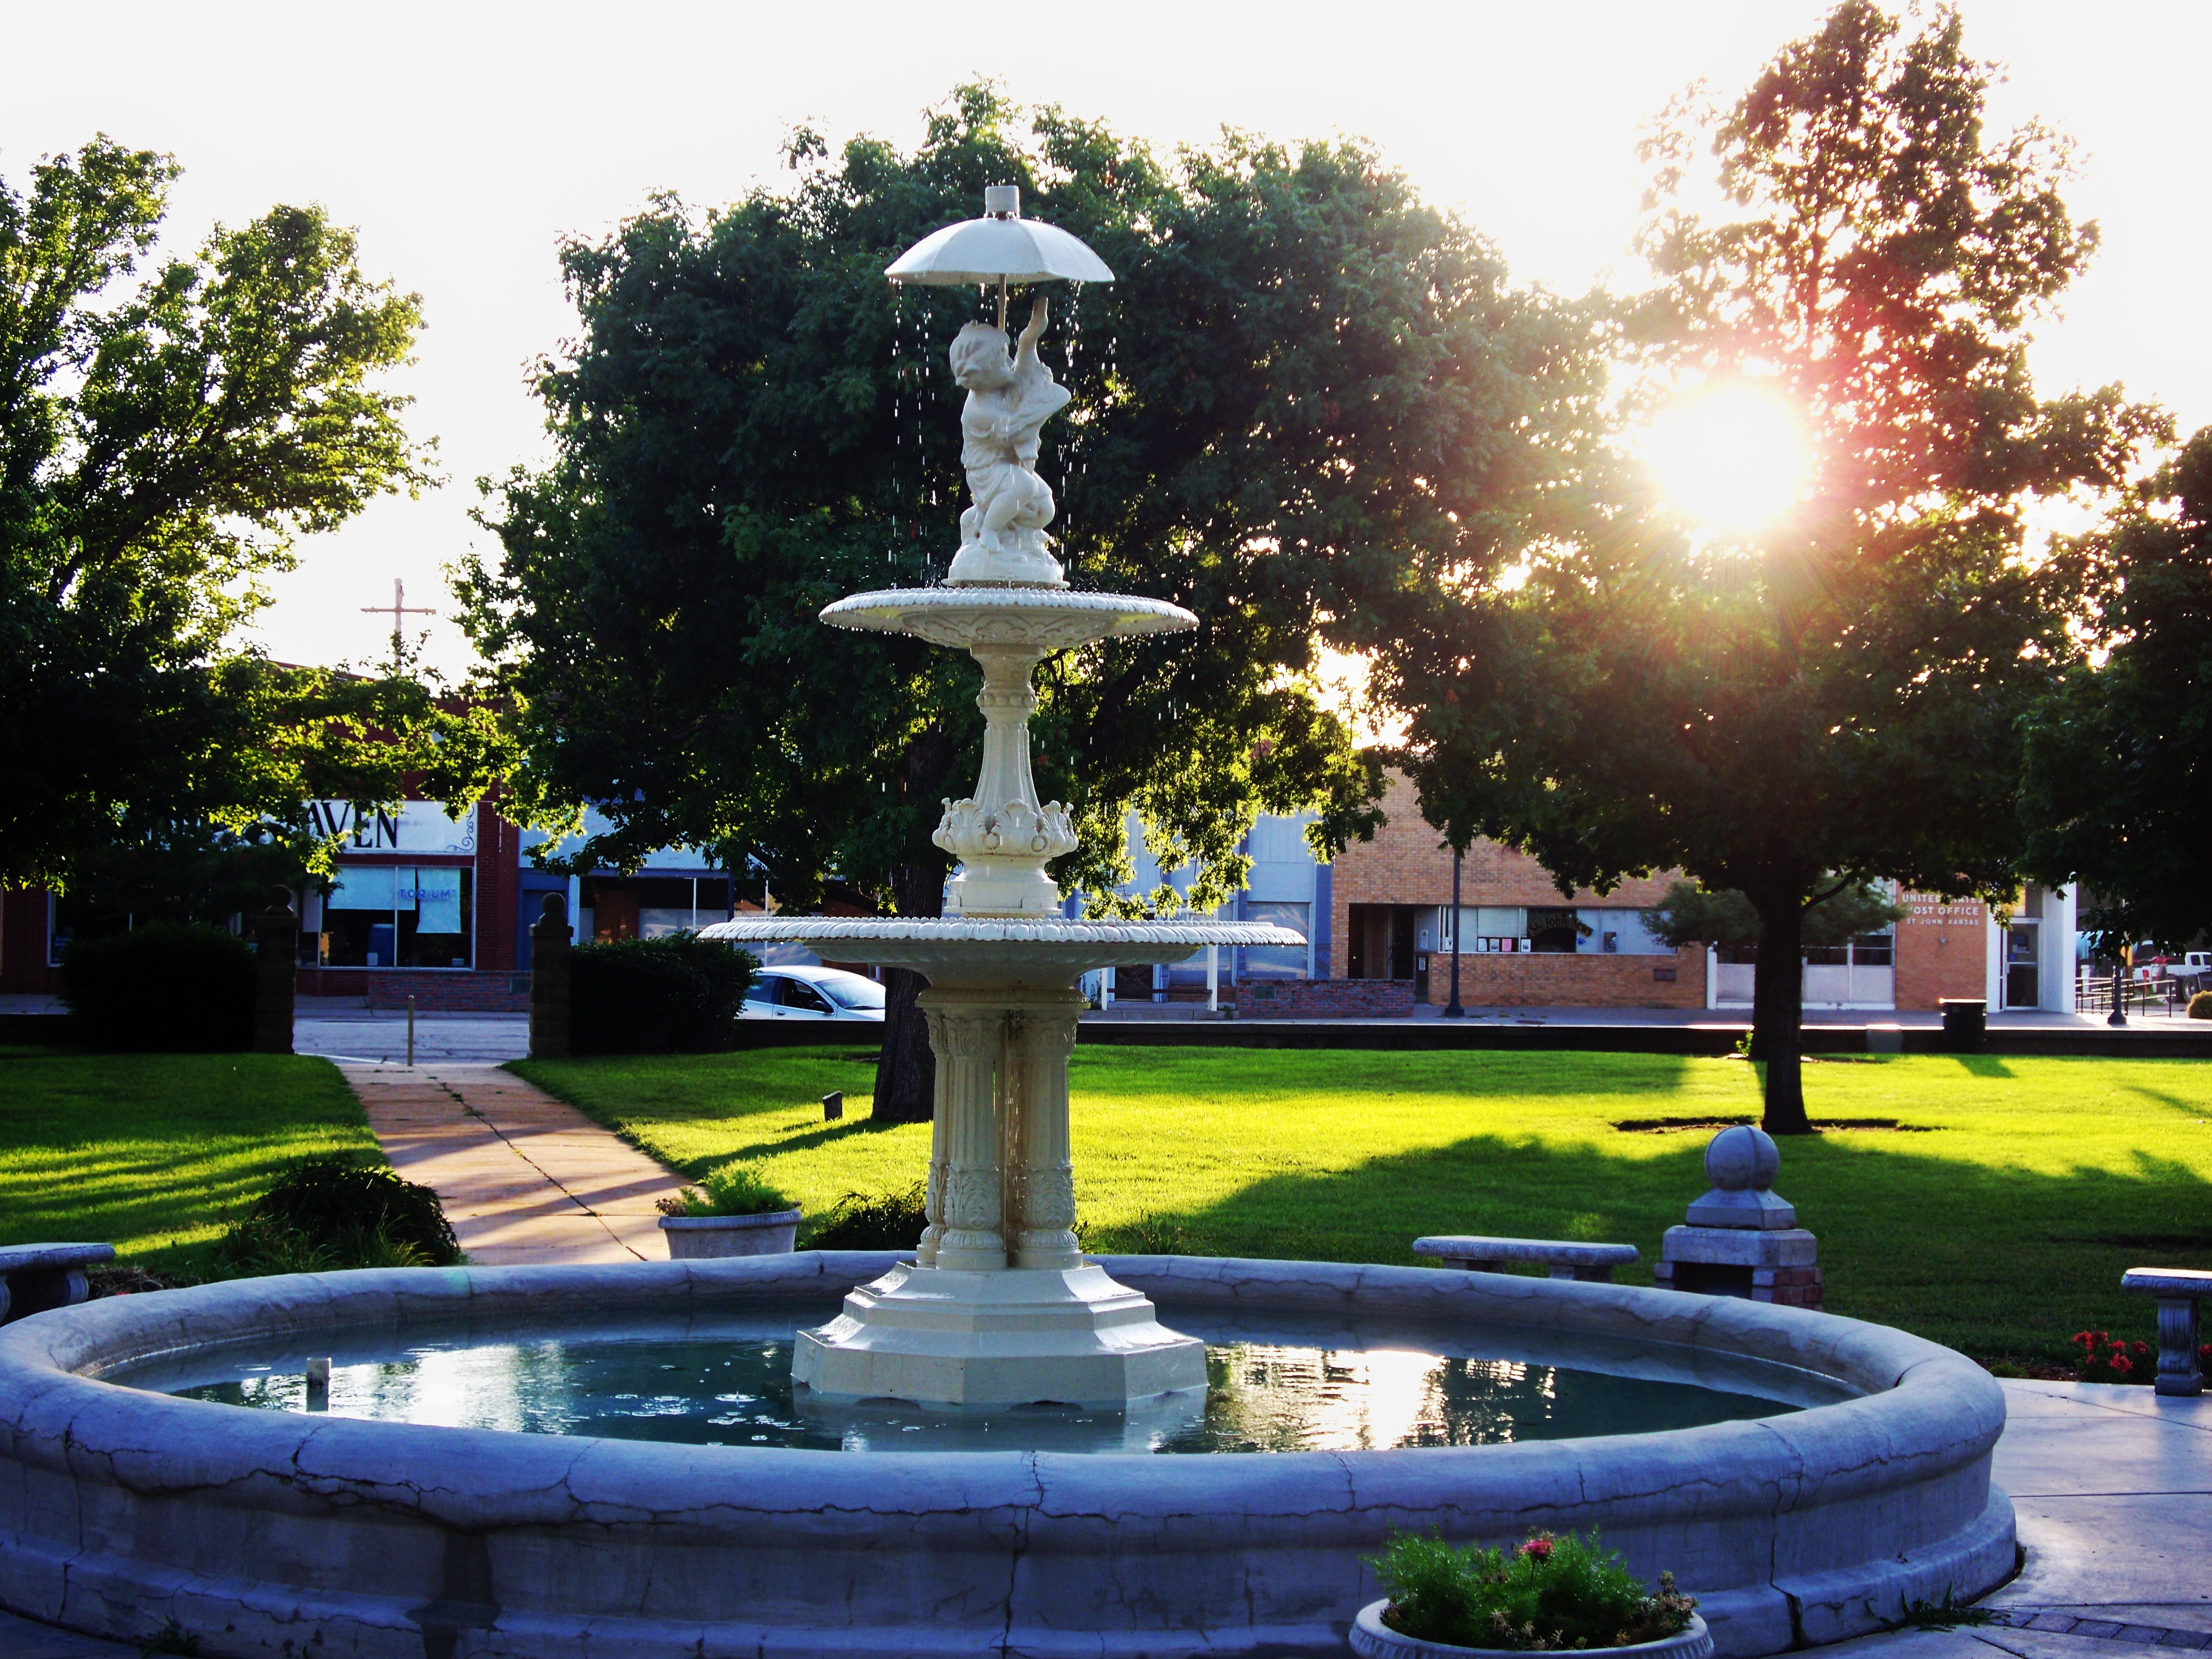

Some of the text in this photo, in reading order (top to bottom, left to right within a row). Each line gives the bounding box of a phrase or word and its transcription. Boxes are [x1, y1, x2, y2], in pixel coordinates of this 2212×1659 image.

[1902, 894, 1983, 903] UNITED ATES
[1938, 907, 1979, 915] OFFICE
[1544, 915, 1566, 928] John
[1570, 917, 1593, 937] News
